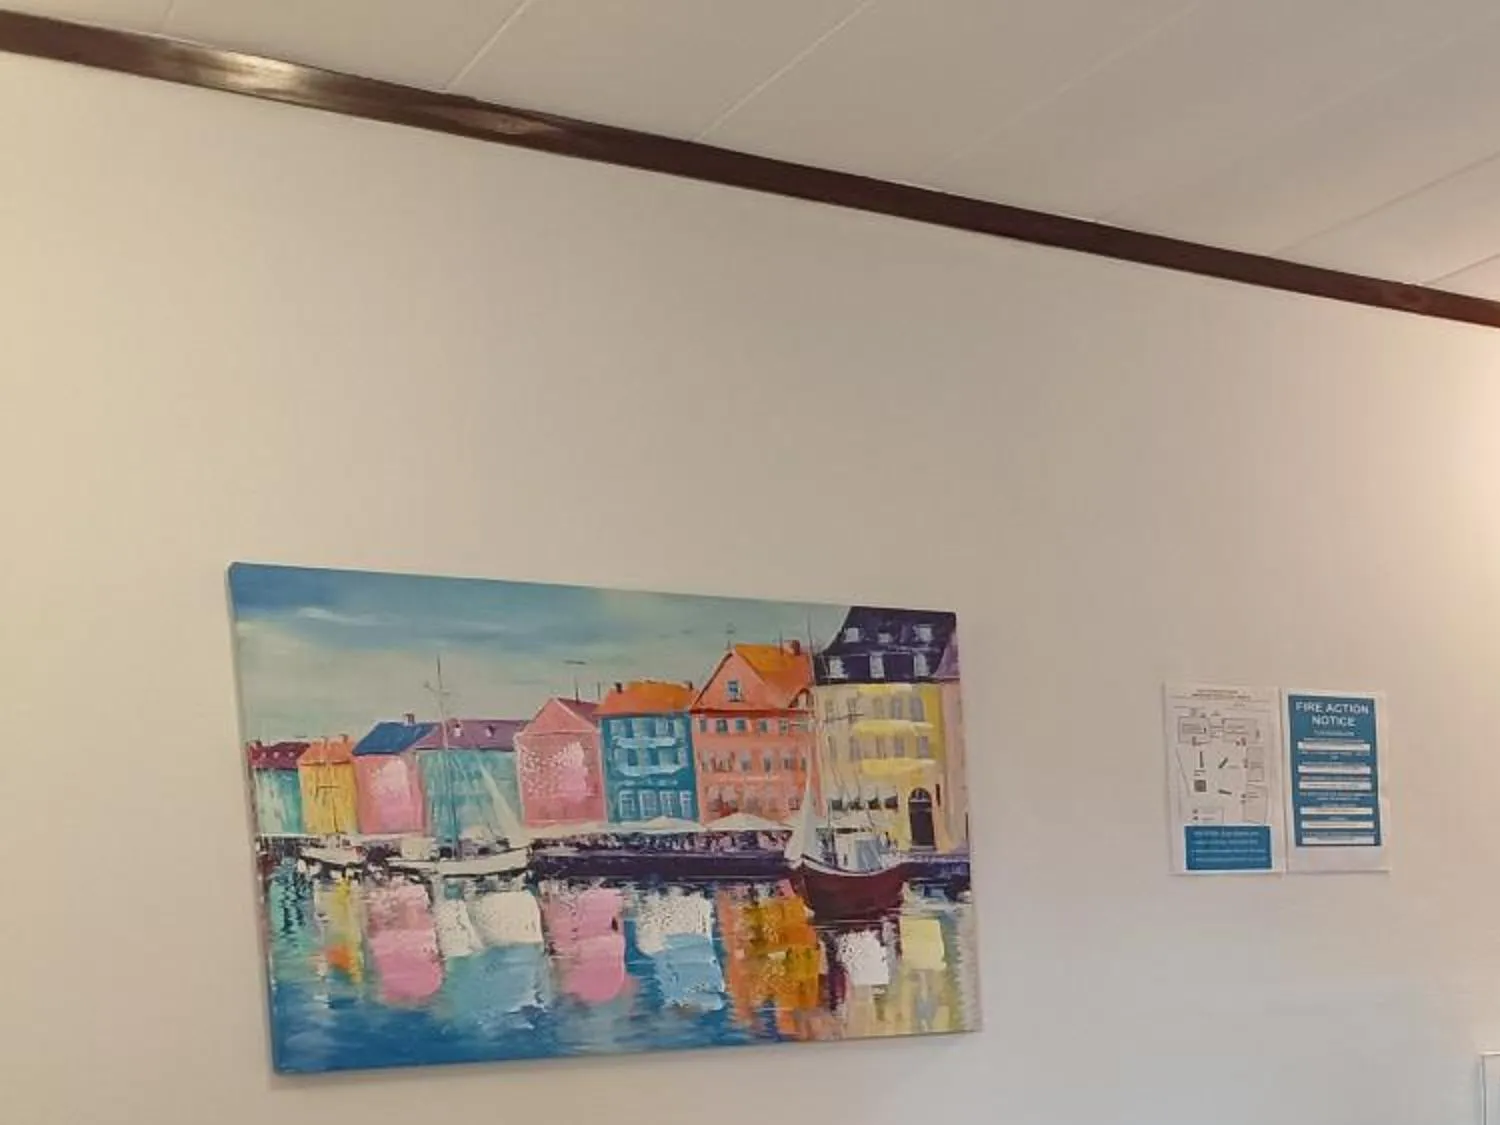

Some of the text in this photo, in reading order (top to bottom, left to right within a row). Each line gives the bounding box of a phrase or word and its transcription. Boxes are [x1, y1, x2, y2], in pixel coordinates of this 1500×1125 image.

[1295, 701, 1369, 715] FIRE ACTION
[1311, 715, 1356, 727] NOTICE
